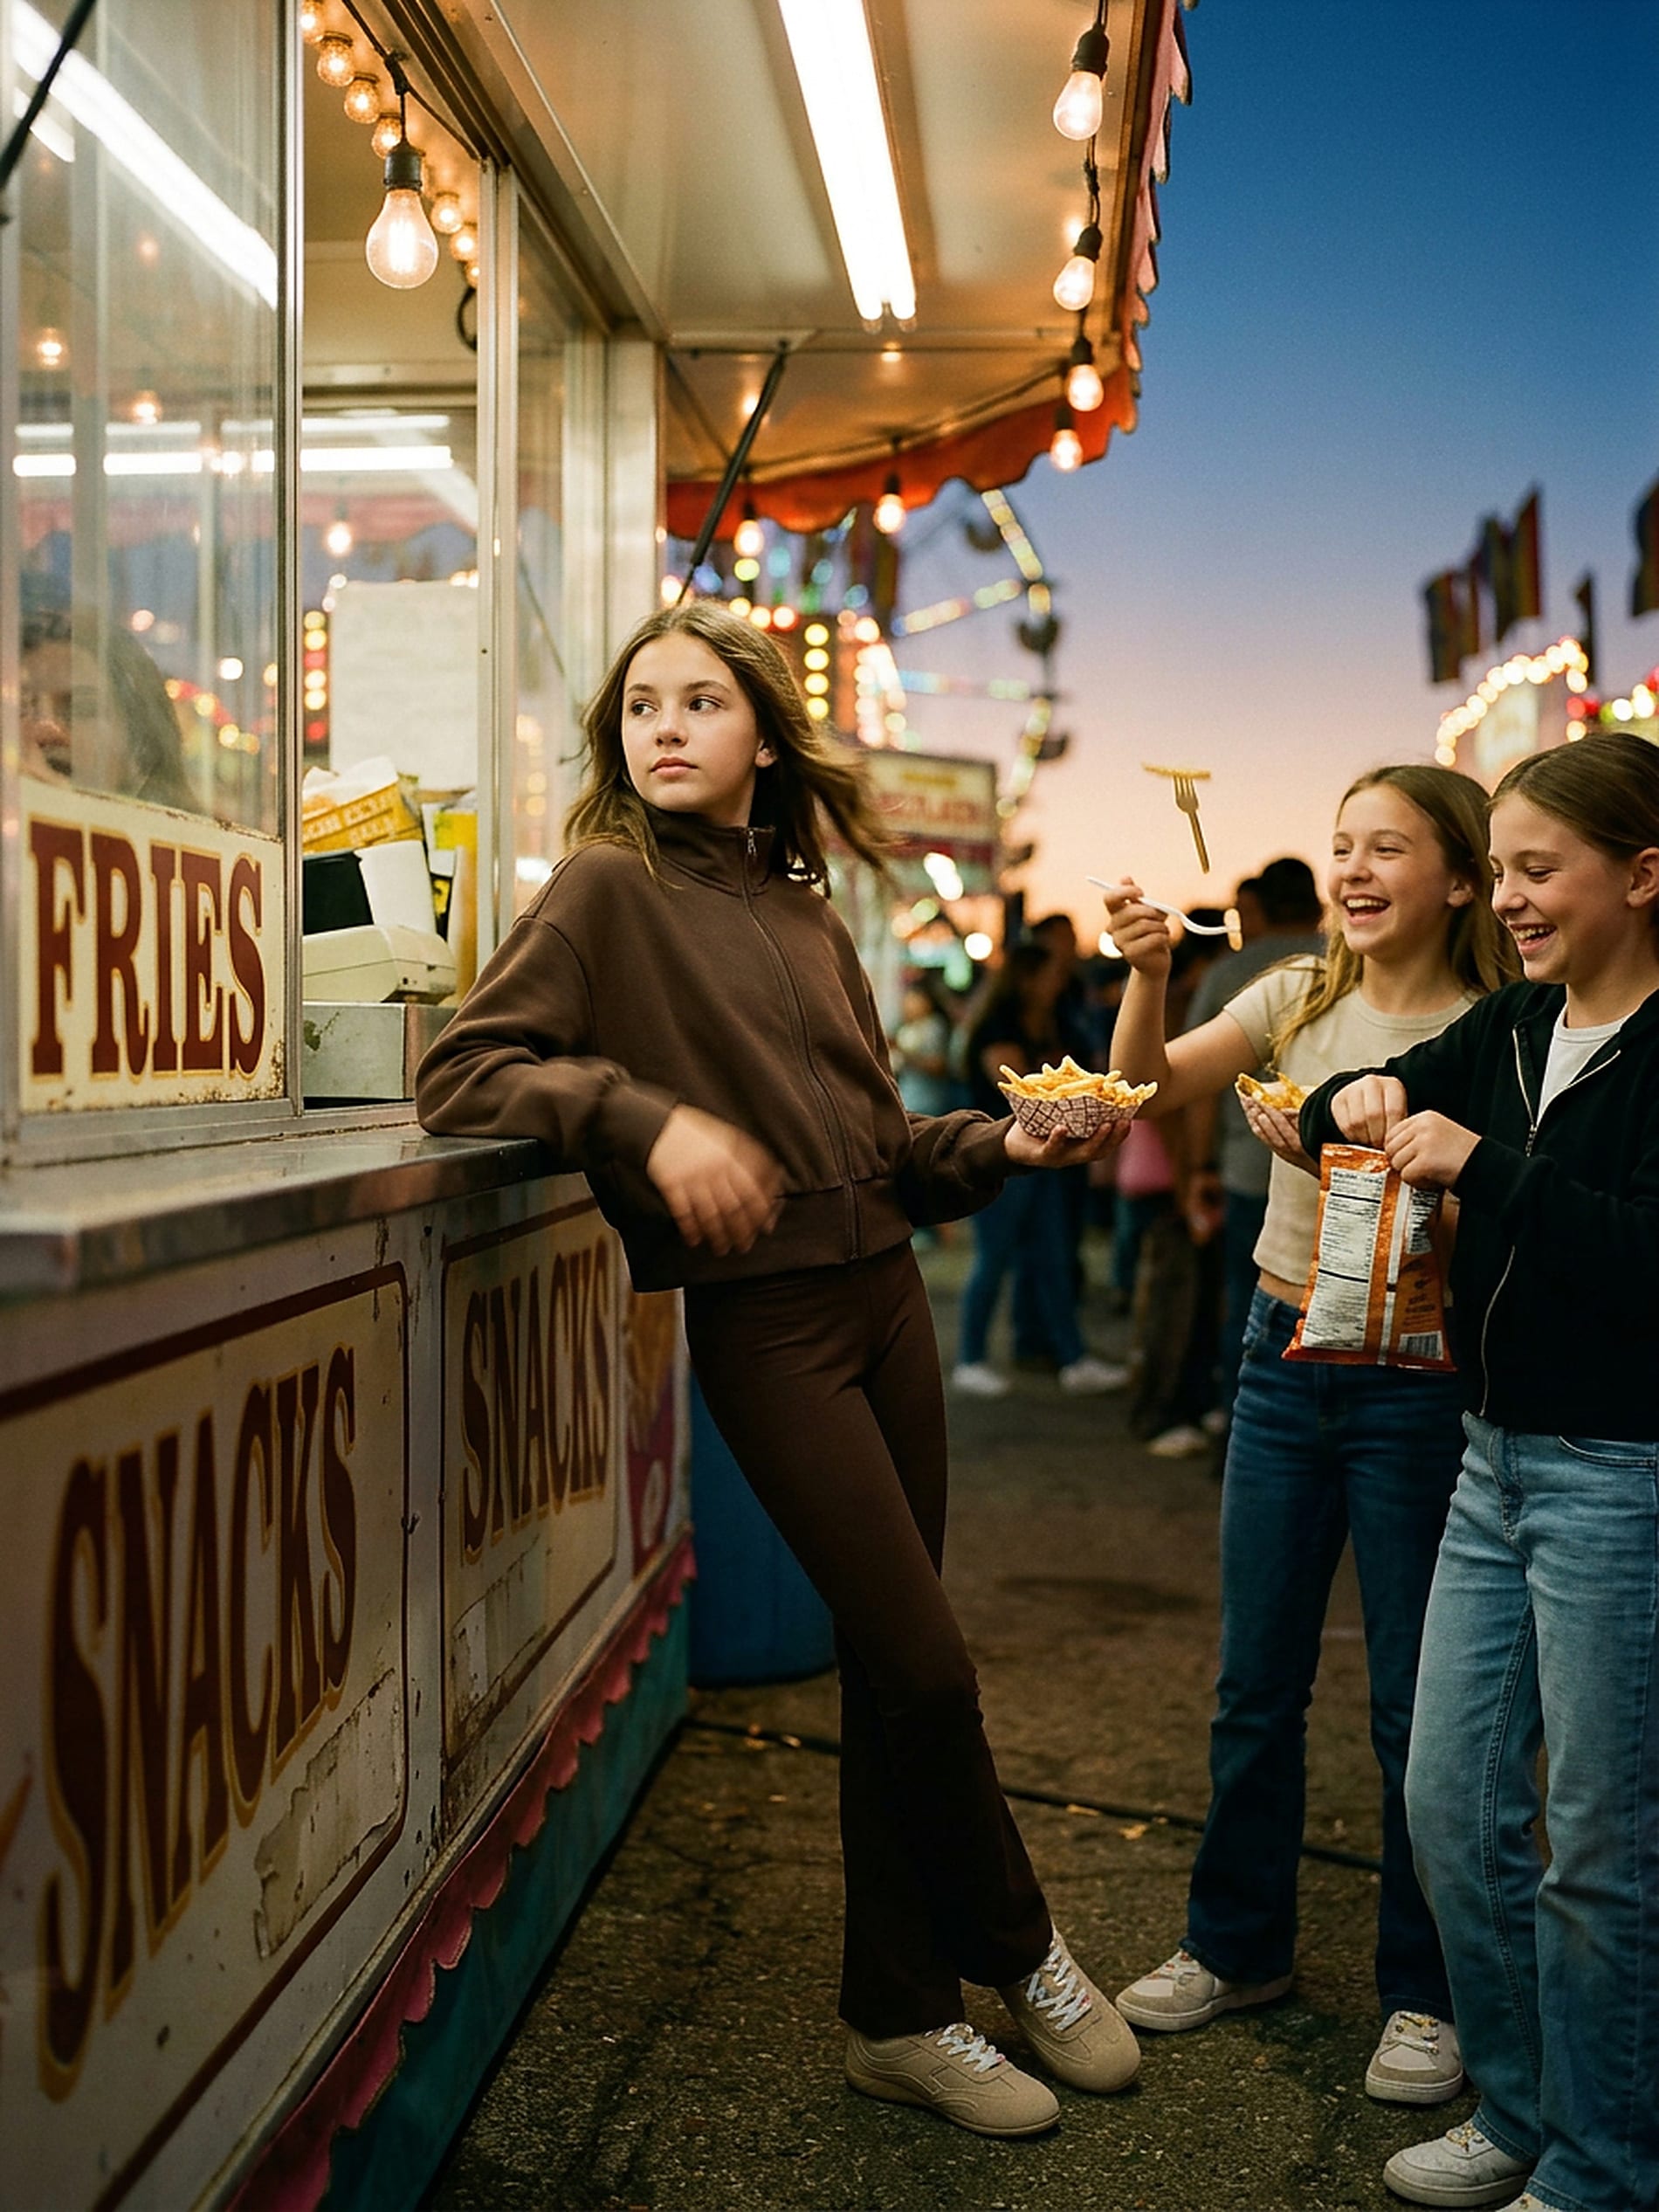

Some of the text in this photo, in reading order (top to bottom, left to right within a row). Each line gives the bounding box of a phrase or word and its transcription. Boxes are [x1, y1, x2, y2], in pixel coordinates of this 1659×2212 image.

[29, 814, 265, 1083] FRIES
[460, 1234, 610, 1565] SNACKS
[38, 1341, 355, 2100] SNACKS
